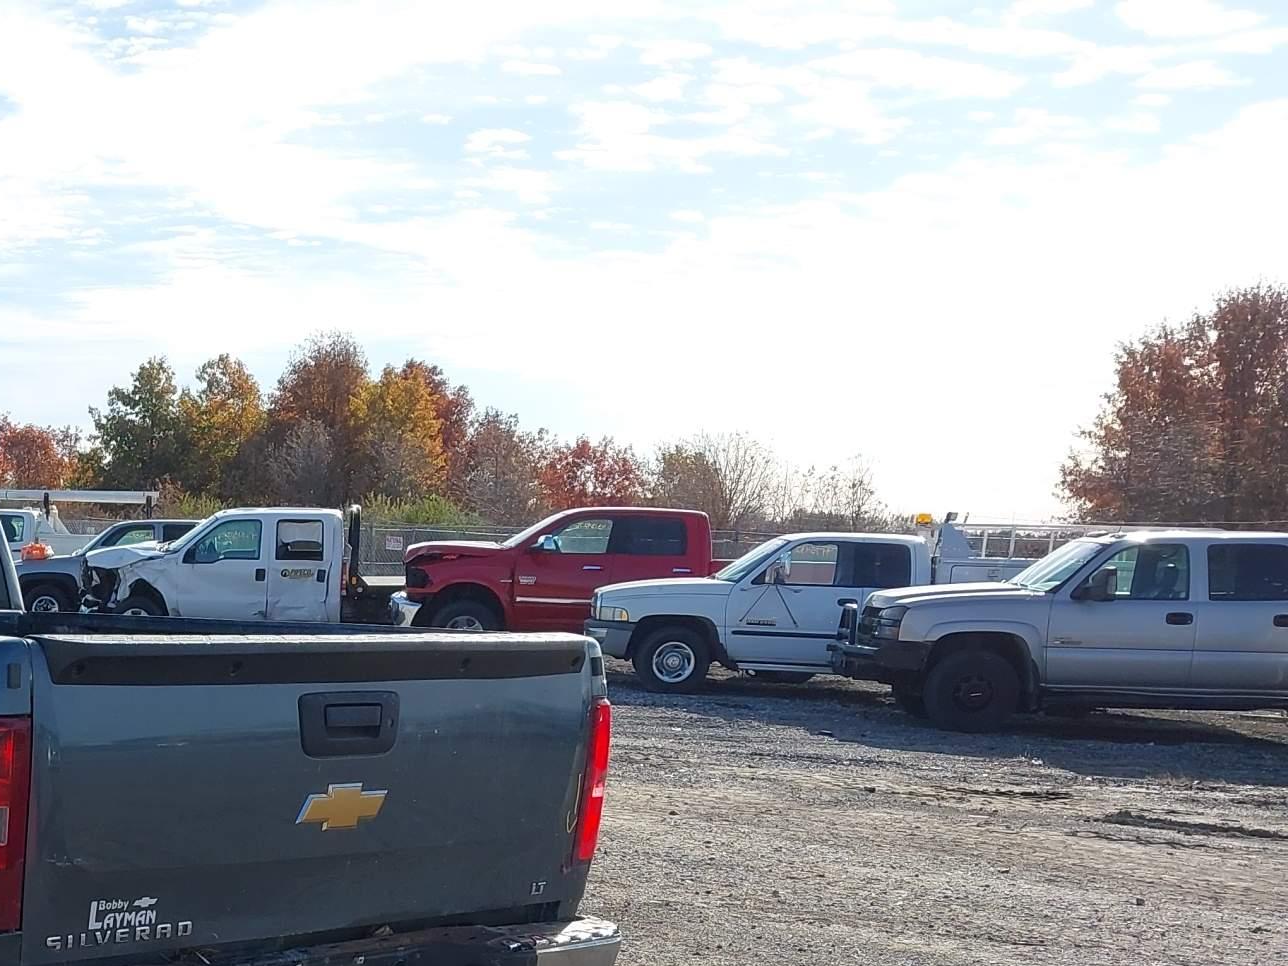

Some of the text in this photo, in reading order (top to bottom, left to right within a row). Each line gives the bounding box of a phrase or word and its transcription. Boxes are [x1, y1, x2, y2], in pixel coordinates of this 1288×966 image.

[530, 881, 547, 896] LT
[88, 901, 157, 931] LAYMAN
[98, 900, 129, 912] Bobby
[46, 920, 193, 950] SILVERAD
